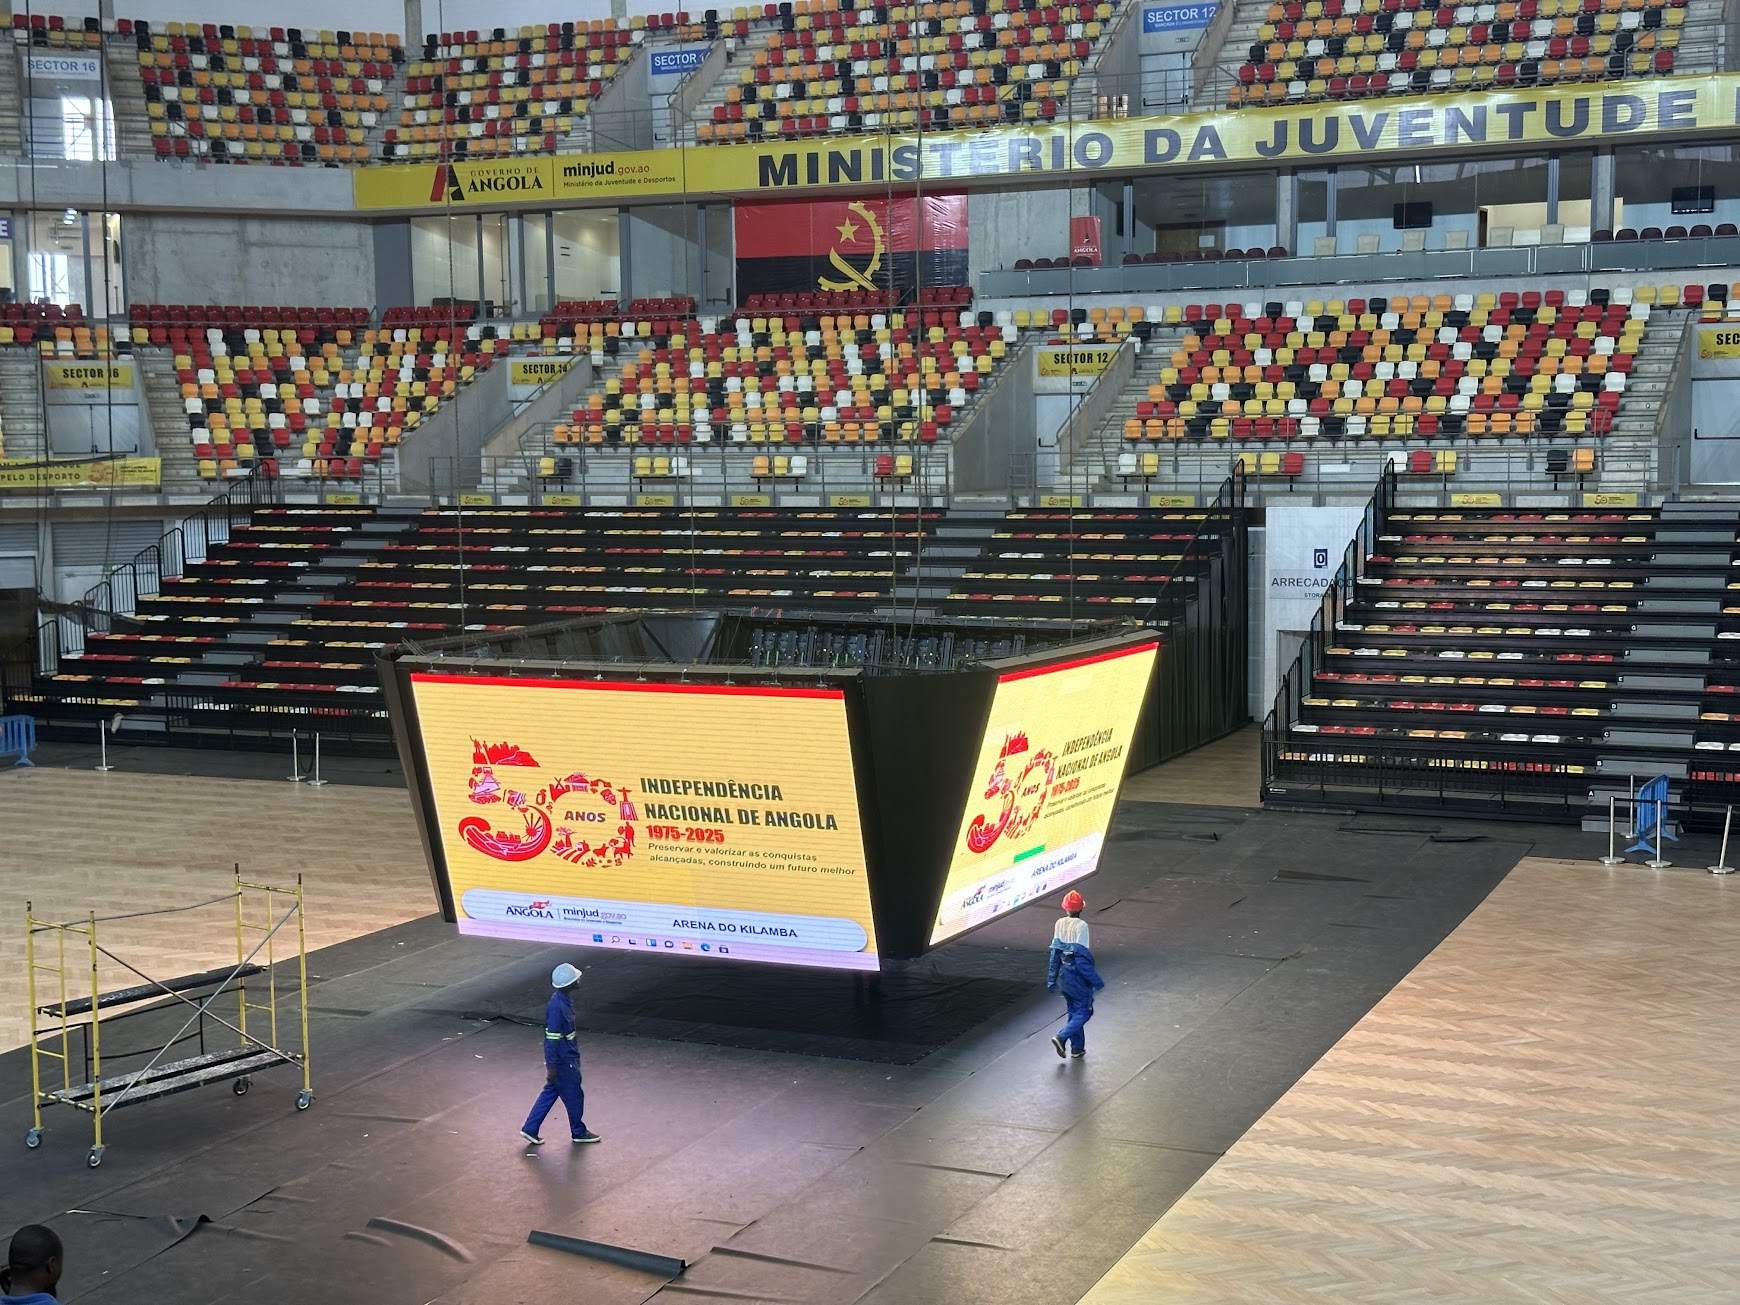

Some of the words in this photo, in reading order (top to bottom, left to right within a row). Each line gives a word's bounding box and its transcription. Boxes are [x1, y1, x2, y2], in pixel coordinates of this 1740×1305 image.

[1147, 8, 1199, 23] SECTOR
[1202, 6, 1217, 18] 12
[29, 60, 79, 71] SECTOR
[82, 62, 96, 72] 16
[654, 53, 697, 66] SECTOR
[758, 132, 1114, 187] MINISTÉRIO
[1143, 125, 1228, 164] DA
[1255, 89, 1697, 157] JUVENTUDE
[470, 167, 521, 178] GOVERNO
[526, 166, 540, 175] DE
[563, 161, 650, 178] minjud.gov.ao
[468, 175, 543, 193] ANGOLA
[604, 177, 636, 186] Juventude
[643, 175, 676, 185] Desportos
[1053, 353, 1093, 364] SECTOR
[1096, 352, 1109, 364] 12
[62, 368, 104, 379] SECTOR
[522, 364, 556, 374] SECTOR
[0, 473, 25, 481] PELO
[29, 473, 81, 481] DESPORTO
[640, 777, 784, 801] INDEPENDÊNCIA
[564, 810, 607, 823] ANOS
[644, 803, 734, 824] NACIONAL
[737, 808, 761, 826] DE
[764, 810, 839, 831] ANGOLA
[646, 824, 725, 843] 1975-2025
[648, 842, 694, 853] Preservar
[704, 847, 747, 857] valorizar
[749, 850, 760, 858] as
[762, 851, 818, 862] conquistas
[649, 854, 706, 867] alcançadas,
[708, 858, 767, 870] construindo
[769, 863, 785, 871] um
[787, 862, 818, 873] futuro
[820, 865, 856, 876] melhor
[506, 906, 554, 919] ANGOLA
[672, 919, 716, 931] ARENA
[718, 923, 737, 933] DO
[740, 925, 798, 938] KILAMBA
